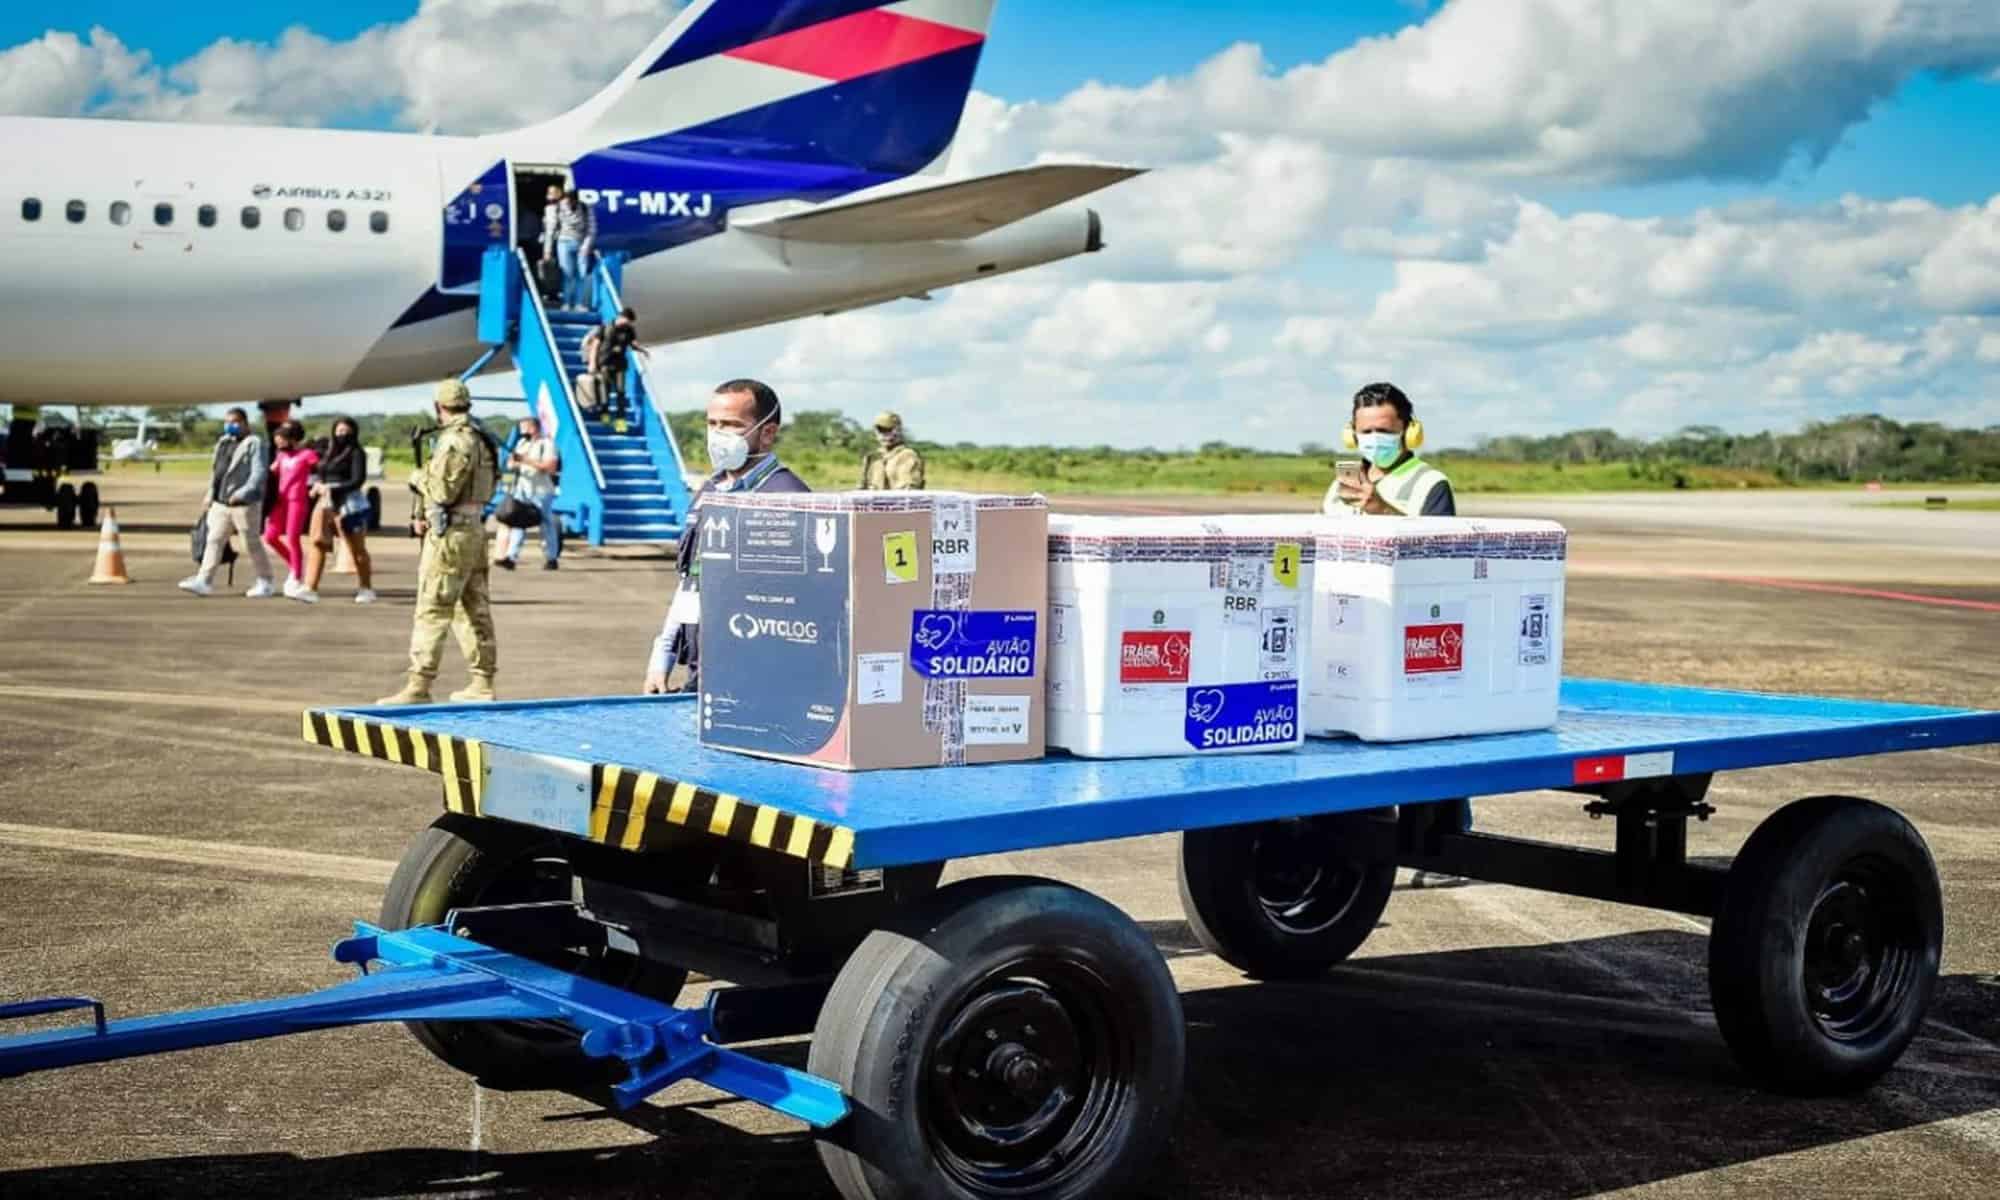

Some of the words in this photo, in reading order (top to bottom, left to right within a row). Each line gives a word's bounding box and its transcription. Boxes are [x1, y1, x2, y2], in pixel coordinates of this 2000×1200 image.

[276, 186, 341, 199] AIRBUS
[346, 189, 391, 201] A321
[578, 189, 712, 217] PT-MXJ
[932, 538, 969, 555] RBR
[895, 548, 908, 567] 1
[1280, 557, 1290, 574] 1
[1224, 595, 1257, 611] RBR
[758, 617, 818, 639] VTCLOG
[985, 636, 1031, 655] AVIÃO
[929, 651, 1031, 674] SOLIDÁRIO
[1254, 704, 1294, 722] AVIÃO
[1203, 716, 1294, 747] SOLIDÁRIO
